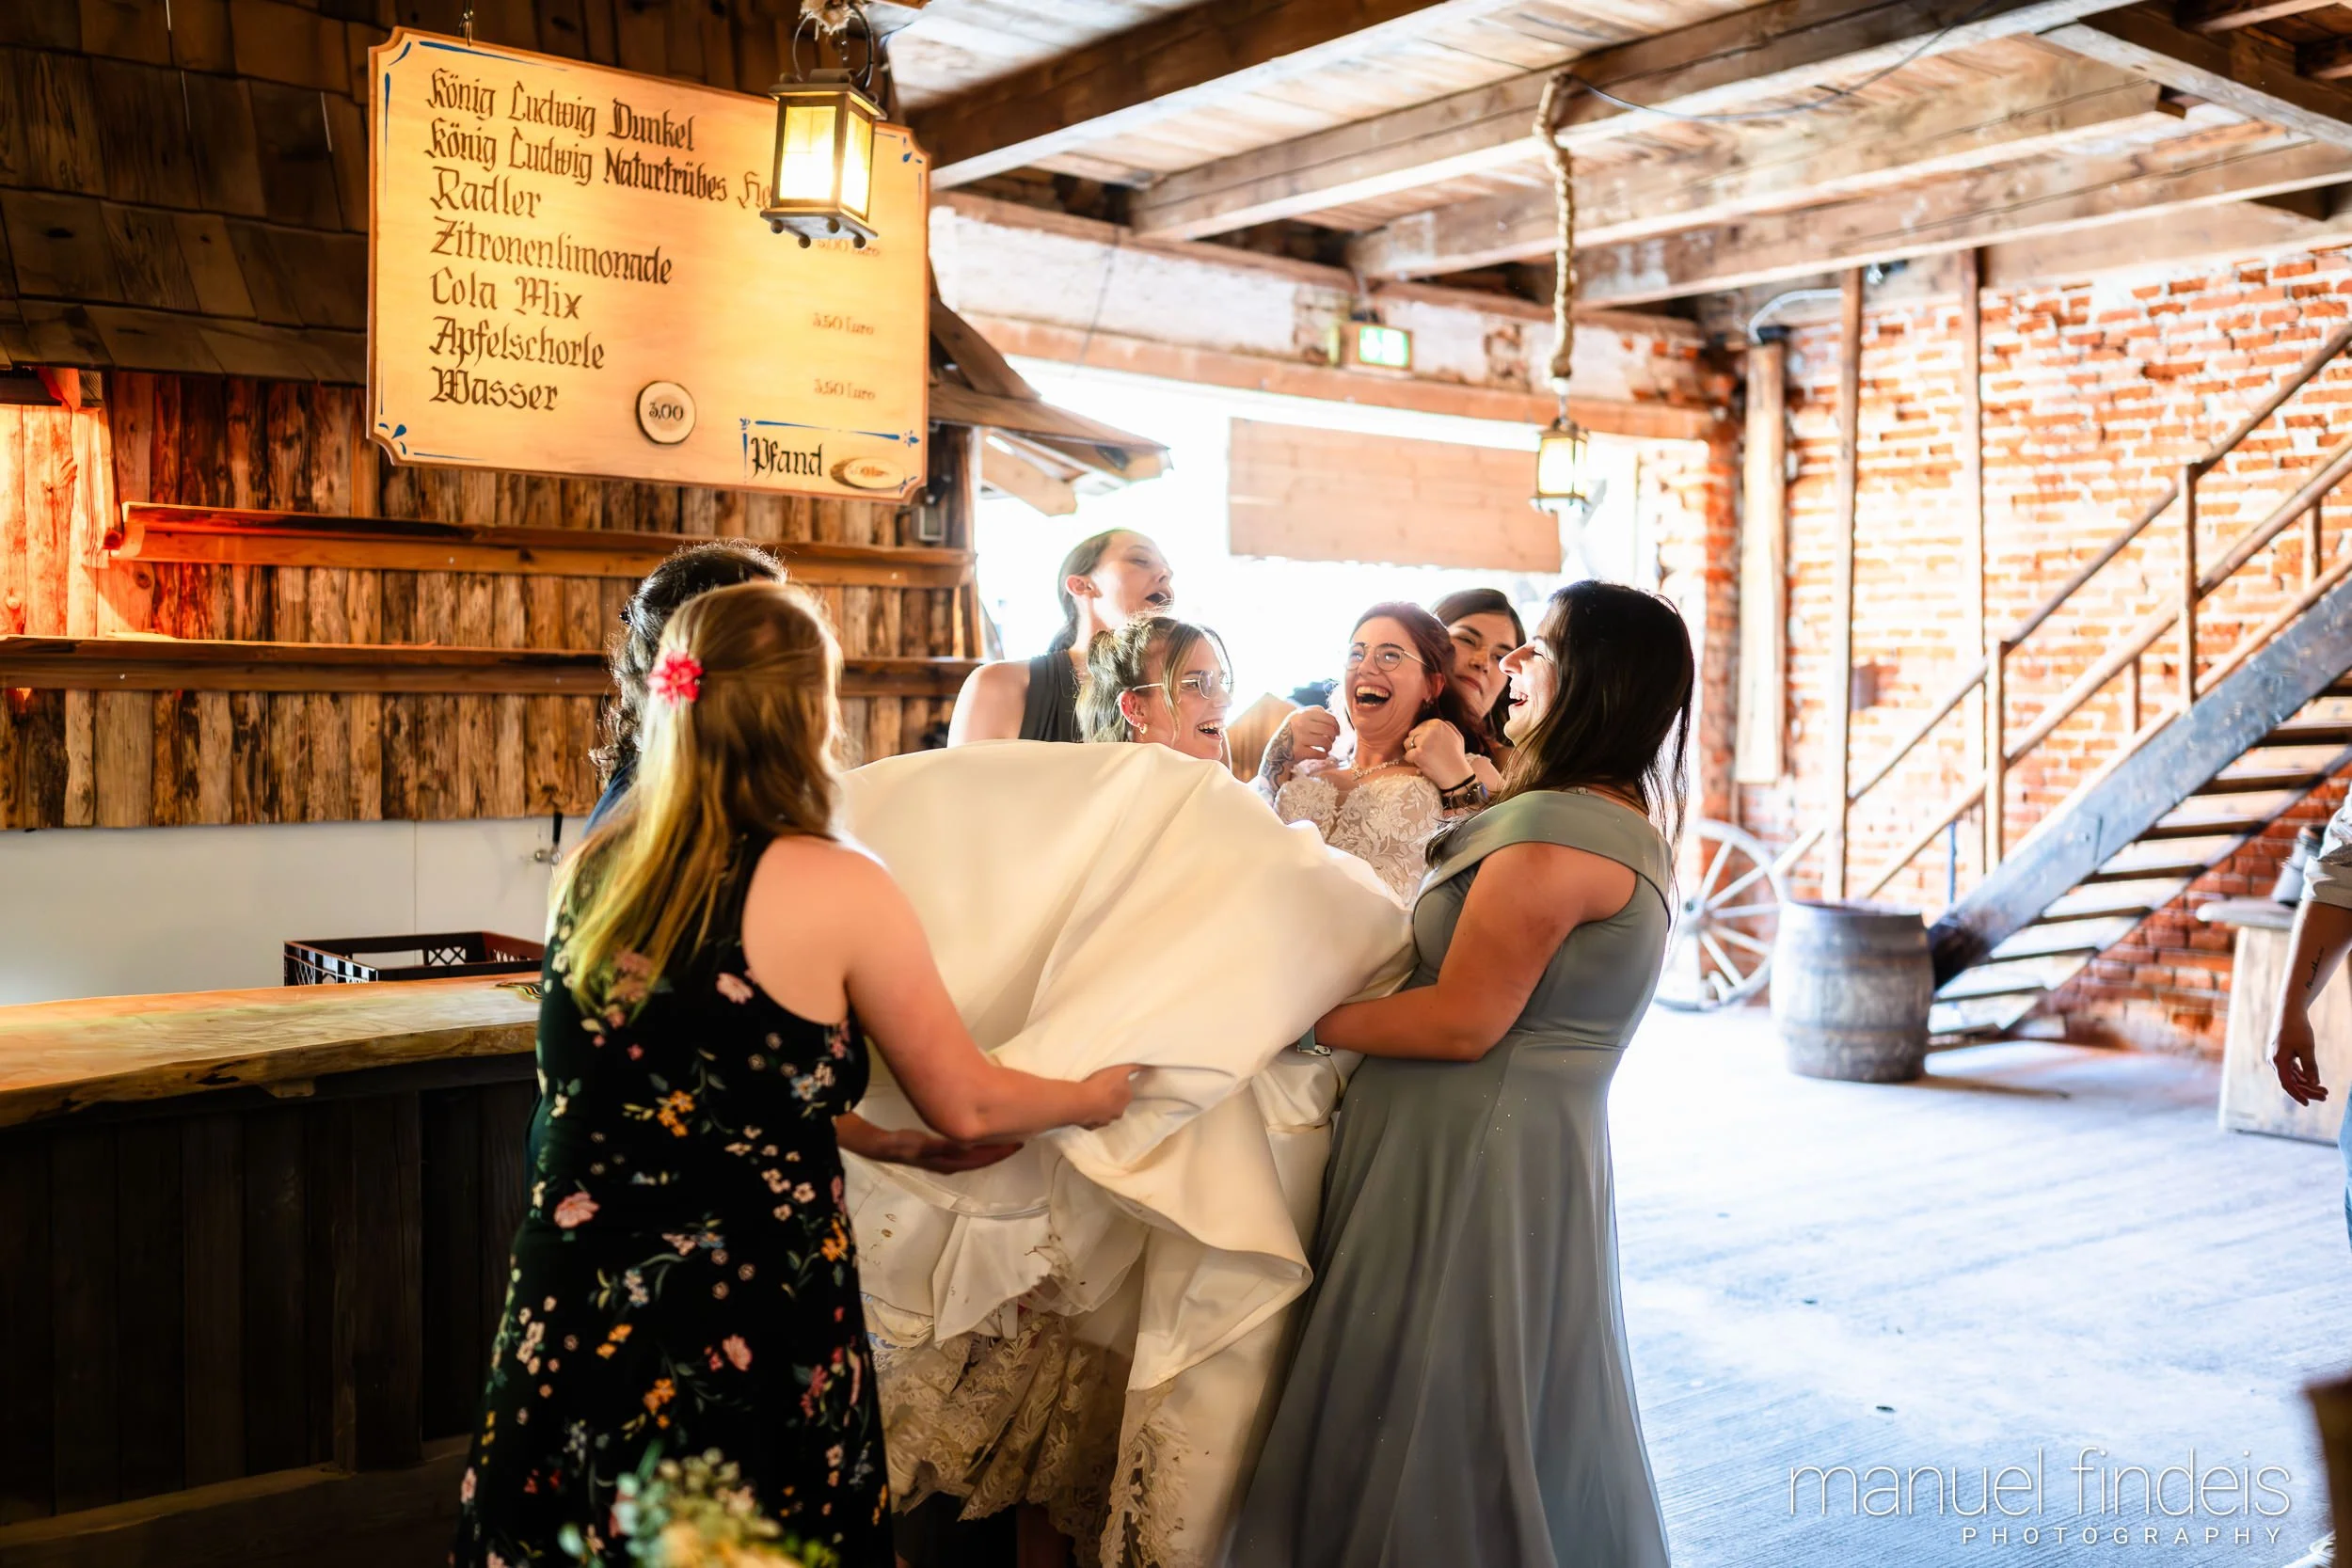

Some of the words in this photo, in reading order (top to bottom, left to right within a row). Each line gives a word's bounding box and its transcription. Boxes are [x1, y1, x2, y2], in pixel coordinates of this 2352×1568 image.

[425, 67, 496, 120] König
[508, 80, 596, 138] Ludwig
[607, 98, 696, 151] Dunkel
[424, 118, 497, 172] König
[508, 126, 594, 186] Ludwig
[603, 147, 727, 201] Naturtrübes
[737, 170, 772, 210] He
[430, 166, 541, 218] Radler
[429, 216, 672, 284] Zitronenlimonade
[429, 266, 498, 309] Cola
[514, 277, 582, 320] Mix
[428, 316, 604, 370] Apfelschorle
[428, 366, 558, 410] Wasser
[648, 402, 684, 421] 3,00
[751, 436, 823, 480] Pfand
